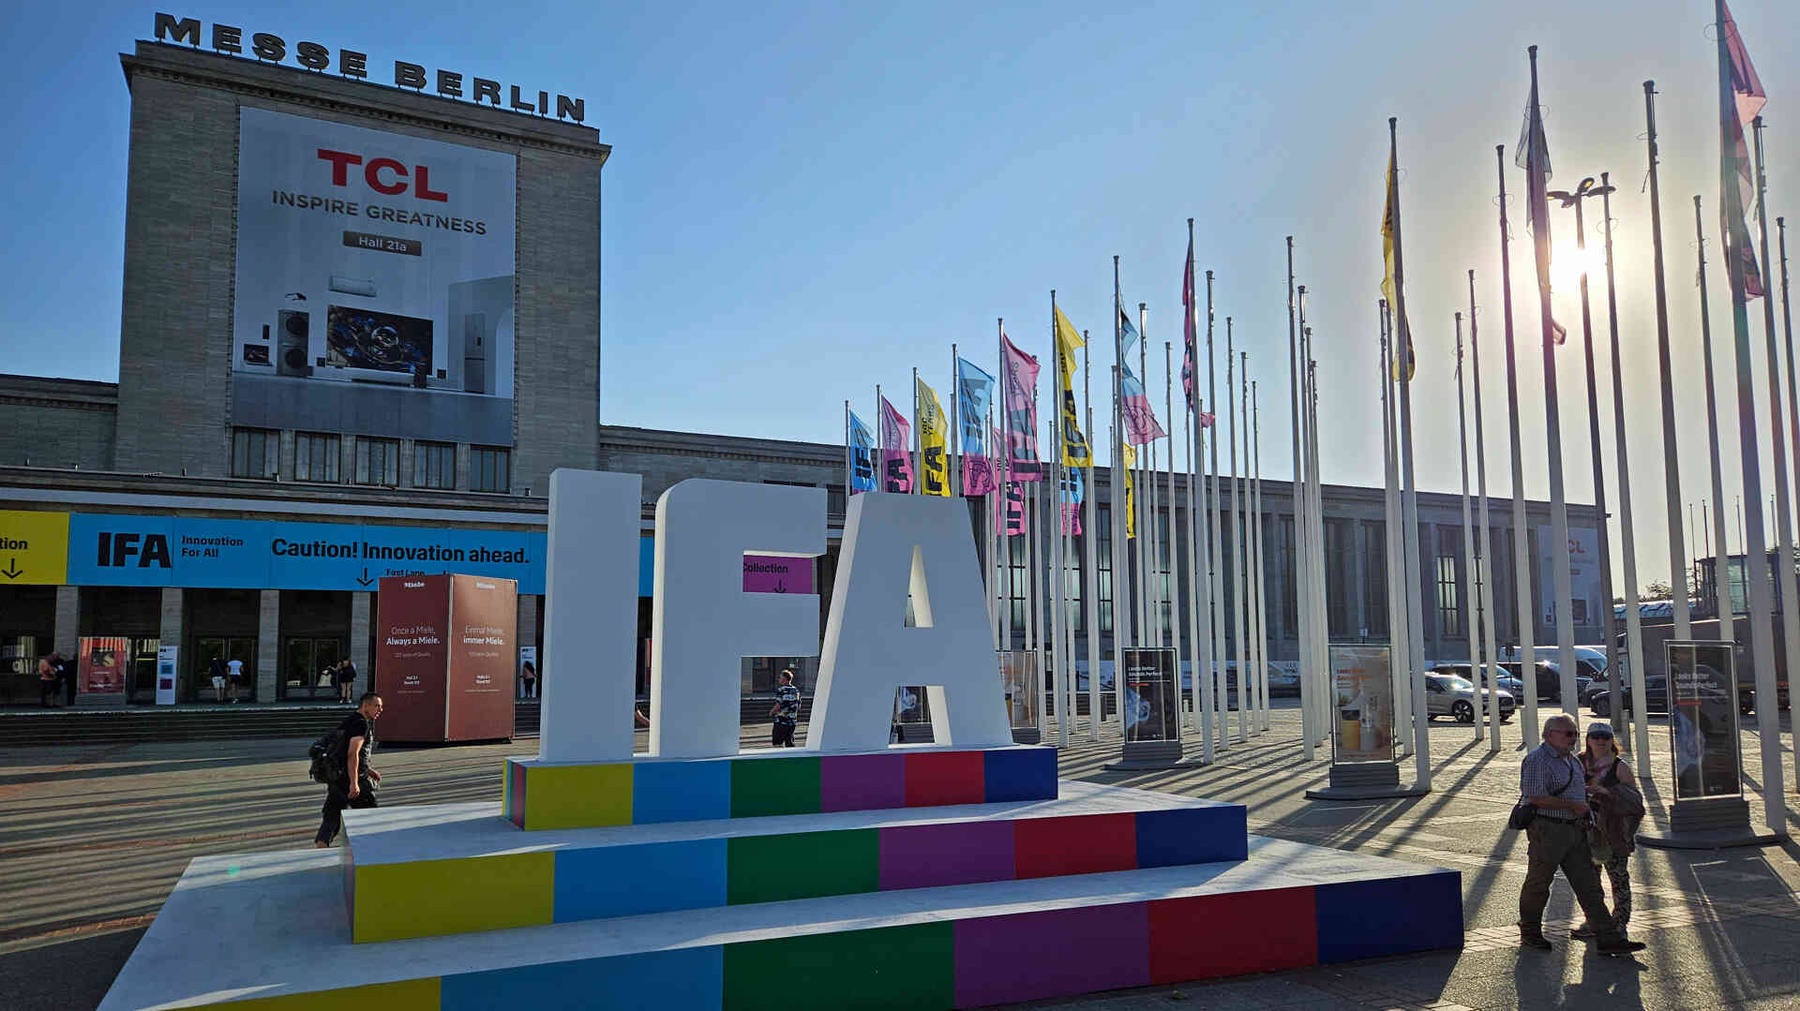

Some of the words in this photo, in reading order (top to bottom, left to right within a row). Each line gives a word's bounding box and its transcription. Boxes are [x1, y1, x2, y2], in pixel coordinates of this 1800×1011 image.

[154, 12, 368, 78] MESSE
[394, 60, 585, 121] BERLIN
[316, 148, 448, 203] TCL
[272, 190, 359, 217] INSPIRE
[366, 203, 487, 236] GREATNESS
[358, 236, 384, 248] Hall
[386, 239, 407, 253] 21a
[924, 446, 943, 496] FA
[0, 537, 28, 550] tion
[97, 531, 172, 568] IFA
[181, 535, 244, 547] Innovation
[271, 537, 358, 558] Caution!
[362, 541, 465, 562] Innovation
[468, 546, 530, 564] ahead.
[181, 547, 200, 558] For
[203, 548, 219, 558] All
[743, 562, 789, 574] Collection
[539, 466, 1014, 763] IFA
[386, 637, 411, 646] Always
[391, 627, 409, 635] Once
